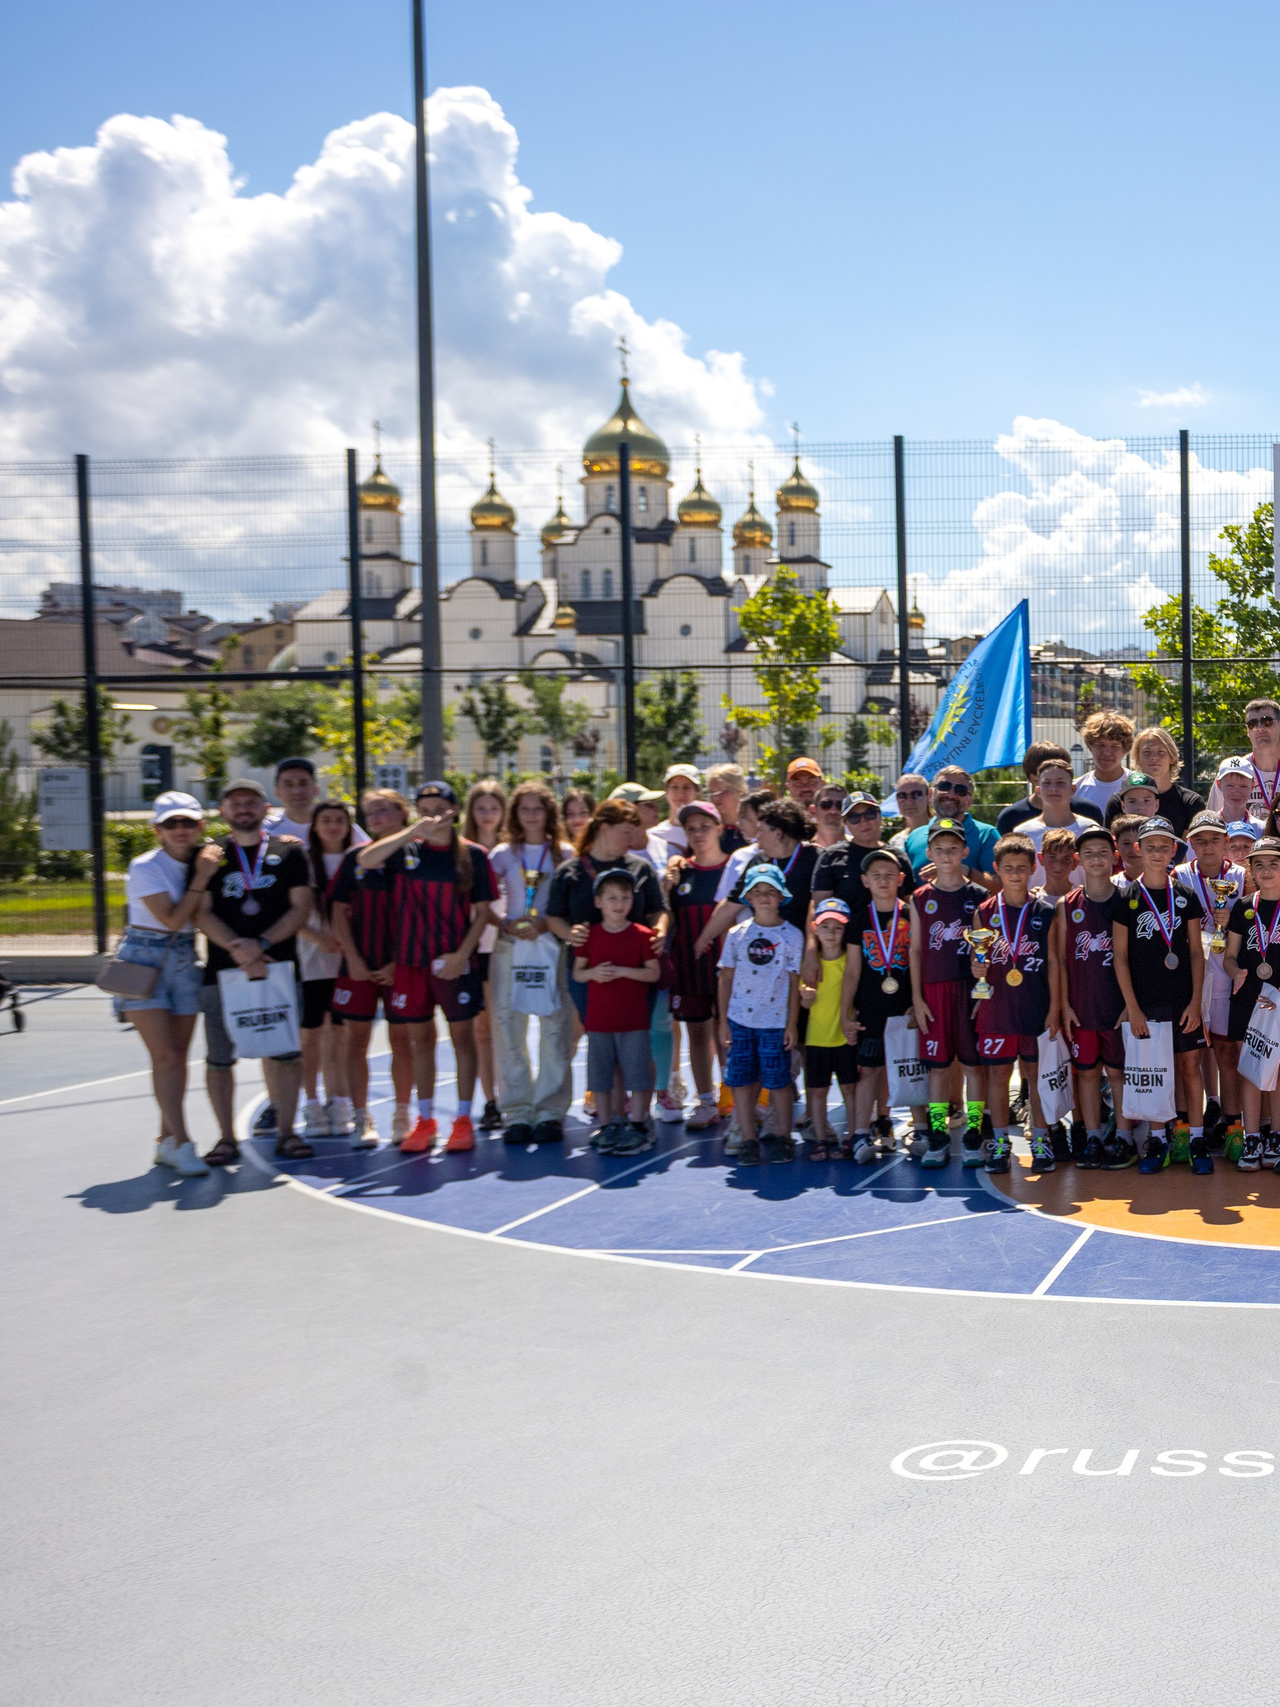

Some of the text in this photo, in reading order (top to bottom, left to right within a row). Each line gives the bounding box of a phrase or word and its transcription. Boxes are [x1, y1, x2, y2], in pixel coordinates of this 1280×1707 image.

[1023, 957, 1044, 972] 27
[984, 1038, 1006, 1055] 27
[1123, 1073, 1163, 1087] RUBIN
